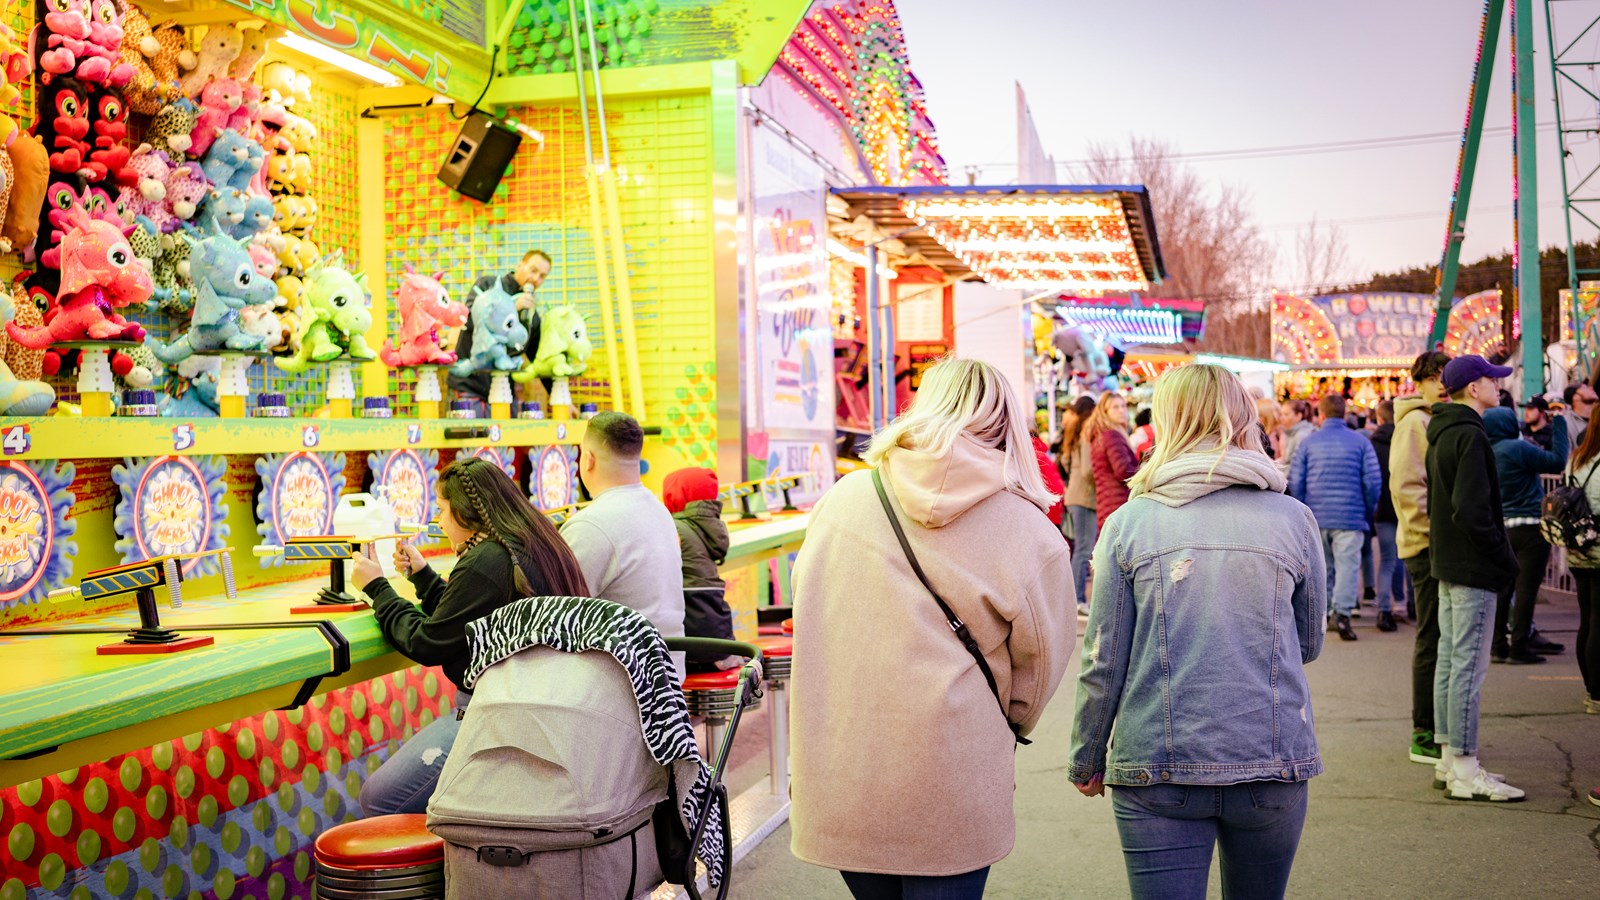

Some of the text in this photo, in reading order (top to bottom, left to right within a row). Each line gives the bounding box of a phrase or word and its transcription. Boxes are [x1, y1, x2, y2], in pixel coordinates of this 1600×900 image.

[226, 0, 451, 93] UN!
[3, 425, 27, 454] 4
[175, 425, 191, 451] 5
[304, 426, 317, 447] 6
[408, 424, 419, 443] 7
[490, 424, 500, 441] 8
[557, 423, 566, 439] 9
[0, 487, 40, 522] OOT
[151, 479, 199, 512] SHOOT
[153, 519, 194, 545] HERE!
[0, 532, 29, 566] RE!
